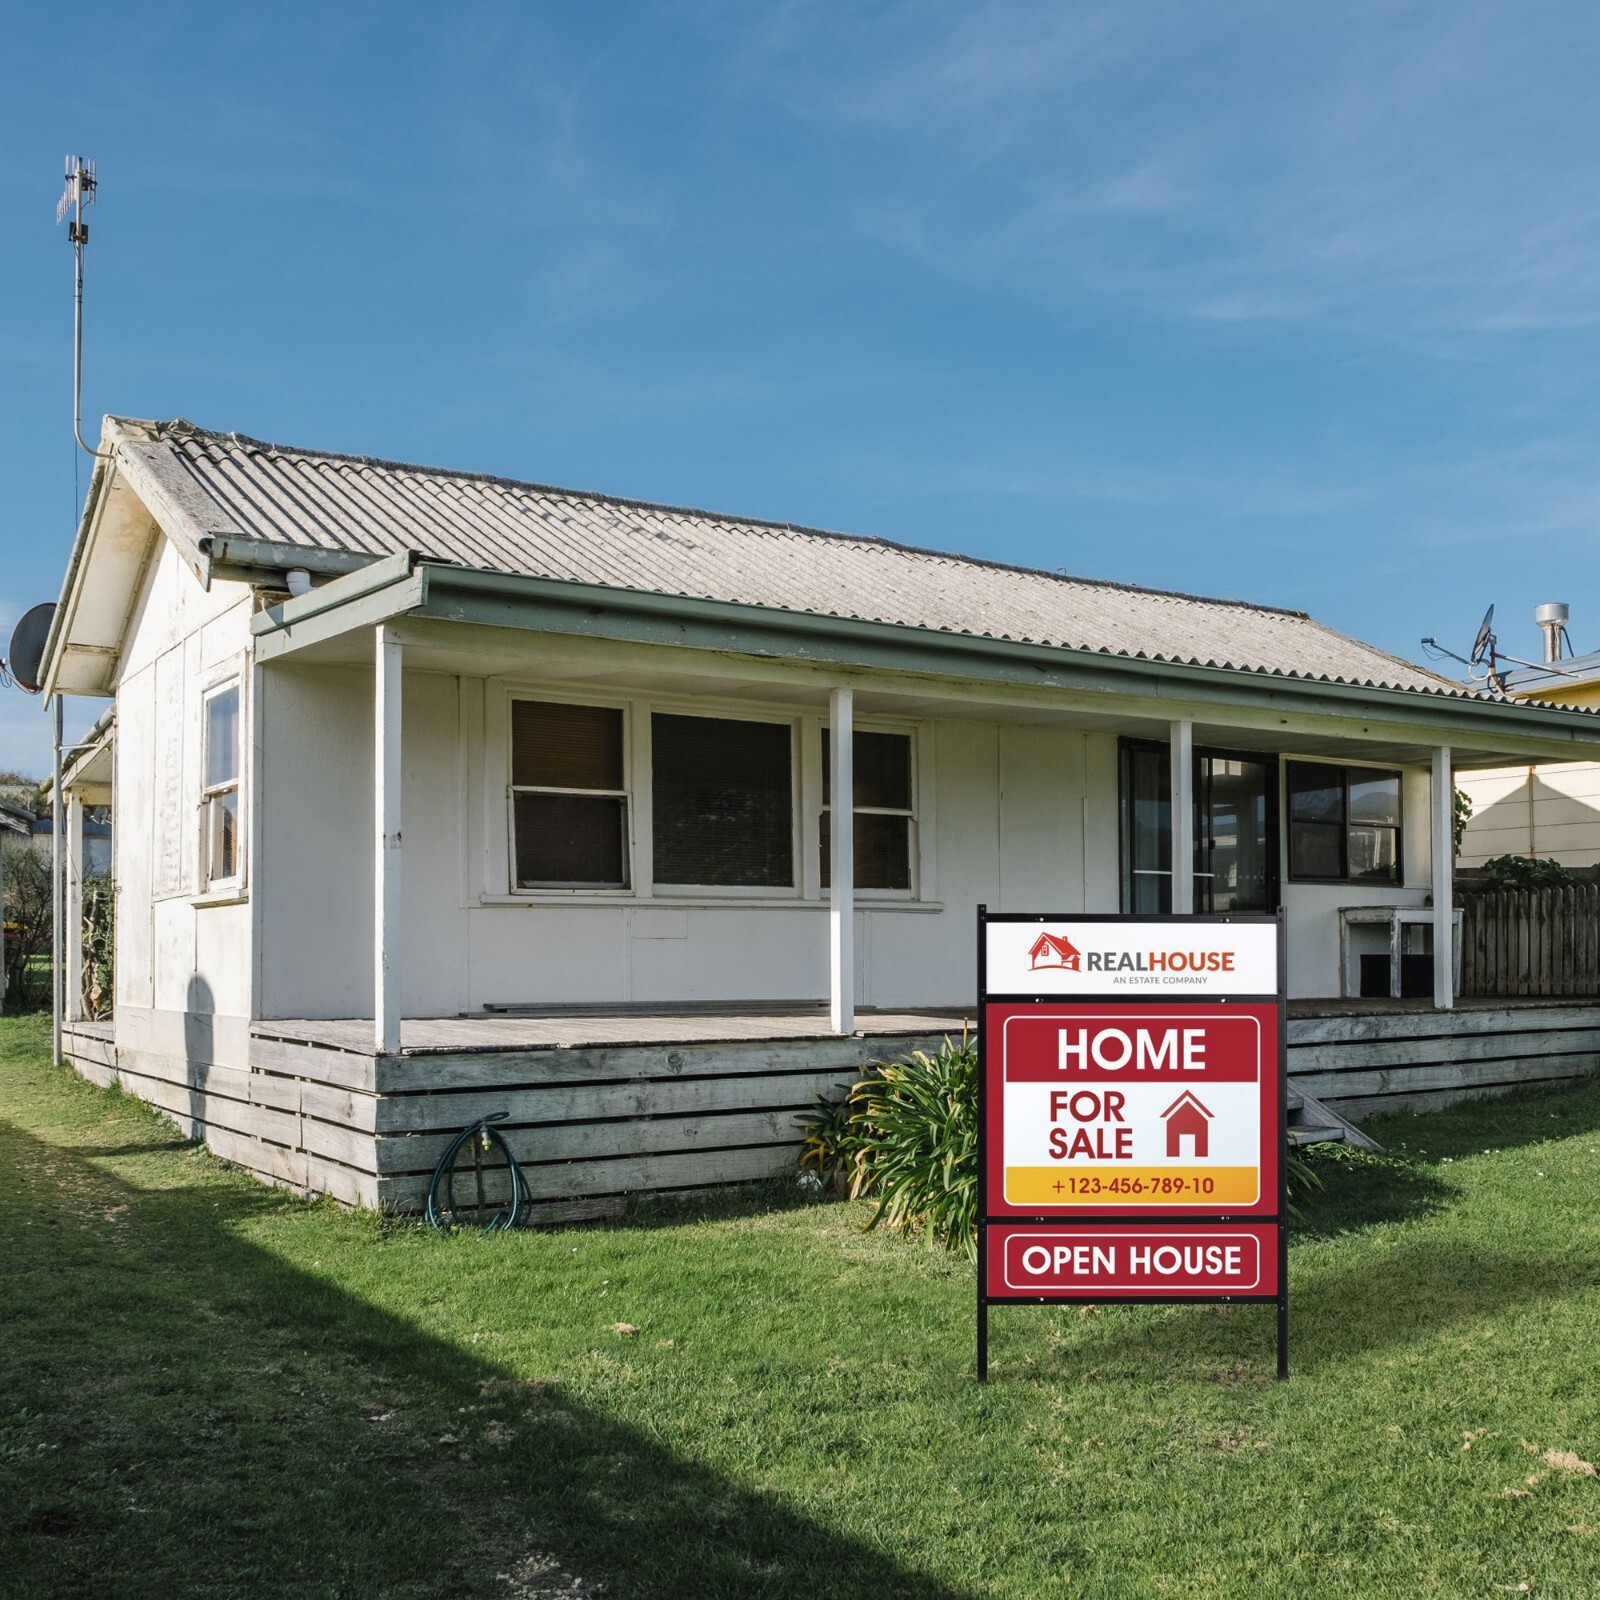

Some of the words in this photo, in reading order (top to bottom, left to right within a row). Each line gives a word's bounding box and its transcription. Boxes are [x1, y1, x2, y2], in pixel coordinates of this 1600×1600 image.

[1087, 951, 1235, 972] REALHOUSE
[1113, 976, 1127, 984] AN
[1129, 976, 1160, 984] ESTATE
[1162, 976, 1208, 984] COMPANY
[1058, 1028, 1206, 1071] HOME
[1050, 1091, 1126, 1122] FOR
[1049, 1128, 1133, 1160] SALE
[1052, 1178, 1214, 1194] +123-456-789-10
[1022, 1245, 1116, 1275] OPEN
[1129, 1245, 1241, 1275] HOUSE
